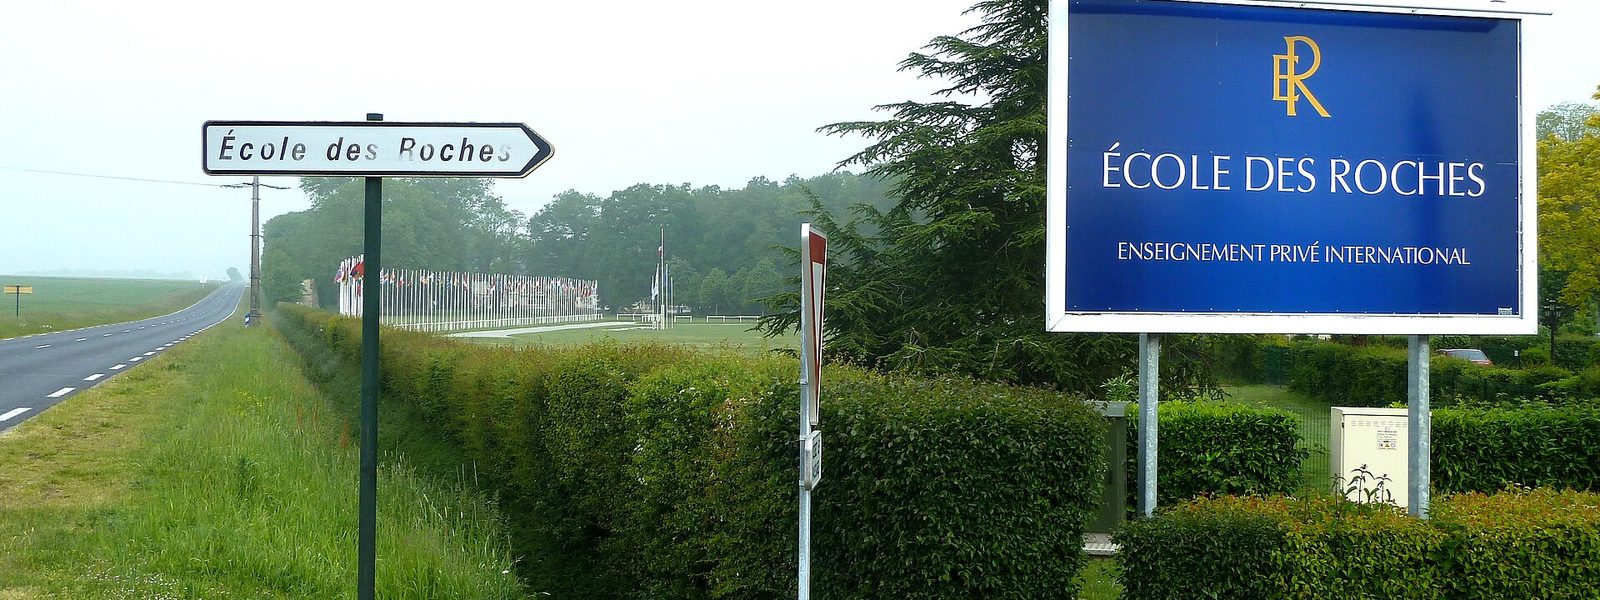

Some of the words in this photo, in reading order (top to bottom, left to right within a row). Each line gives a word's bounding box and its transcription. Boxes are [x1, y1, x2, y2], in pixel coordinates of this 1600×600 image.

[218, 129, 307, 161] École
[326, 137, 379, 162] des
[399, 137, 512, 162] Roches
[1102, 142, 1231, 191] ÉCOLE
[1245, 156, 1316, 193] DES
[1330, 159, 1486, 197] ROCHES
[1117, 242, 1266, 262] ENSEIGNEMENT
[1270, 241, 1320, 263] PRIVÉ
[1325, 246, 1471, 265] INTERNATIONAL
